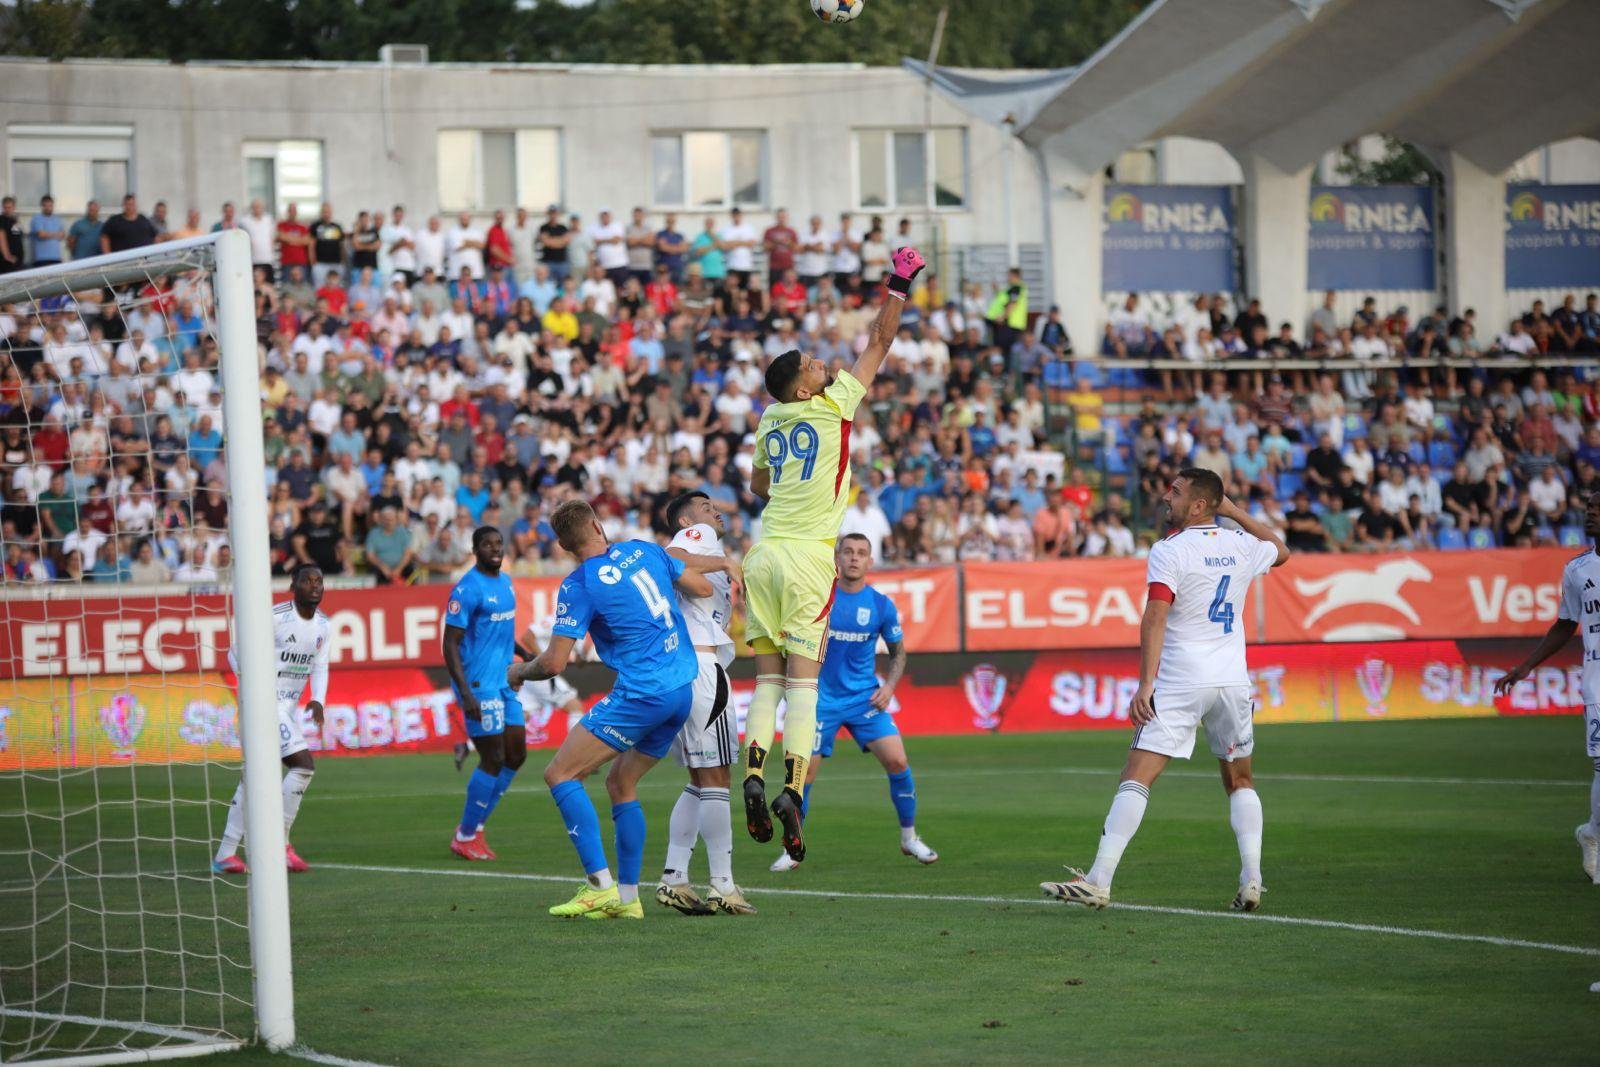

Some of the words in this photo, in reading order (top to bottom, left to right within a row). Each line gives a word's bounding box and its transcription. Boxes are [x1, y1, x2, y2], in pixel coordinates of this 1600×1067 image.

[765, 422, 819, 484] 99
[620, 549, 643, 569] OSCAR
[629, 567, 673, 629] 4
[1208, 575, 1234, 634] 4
